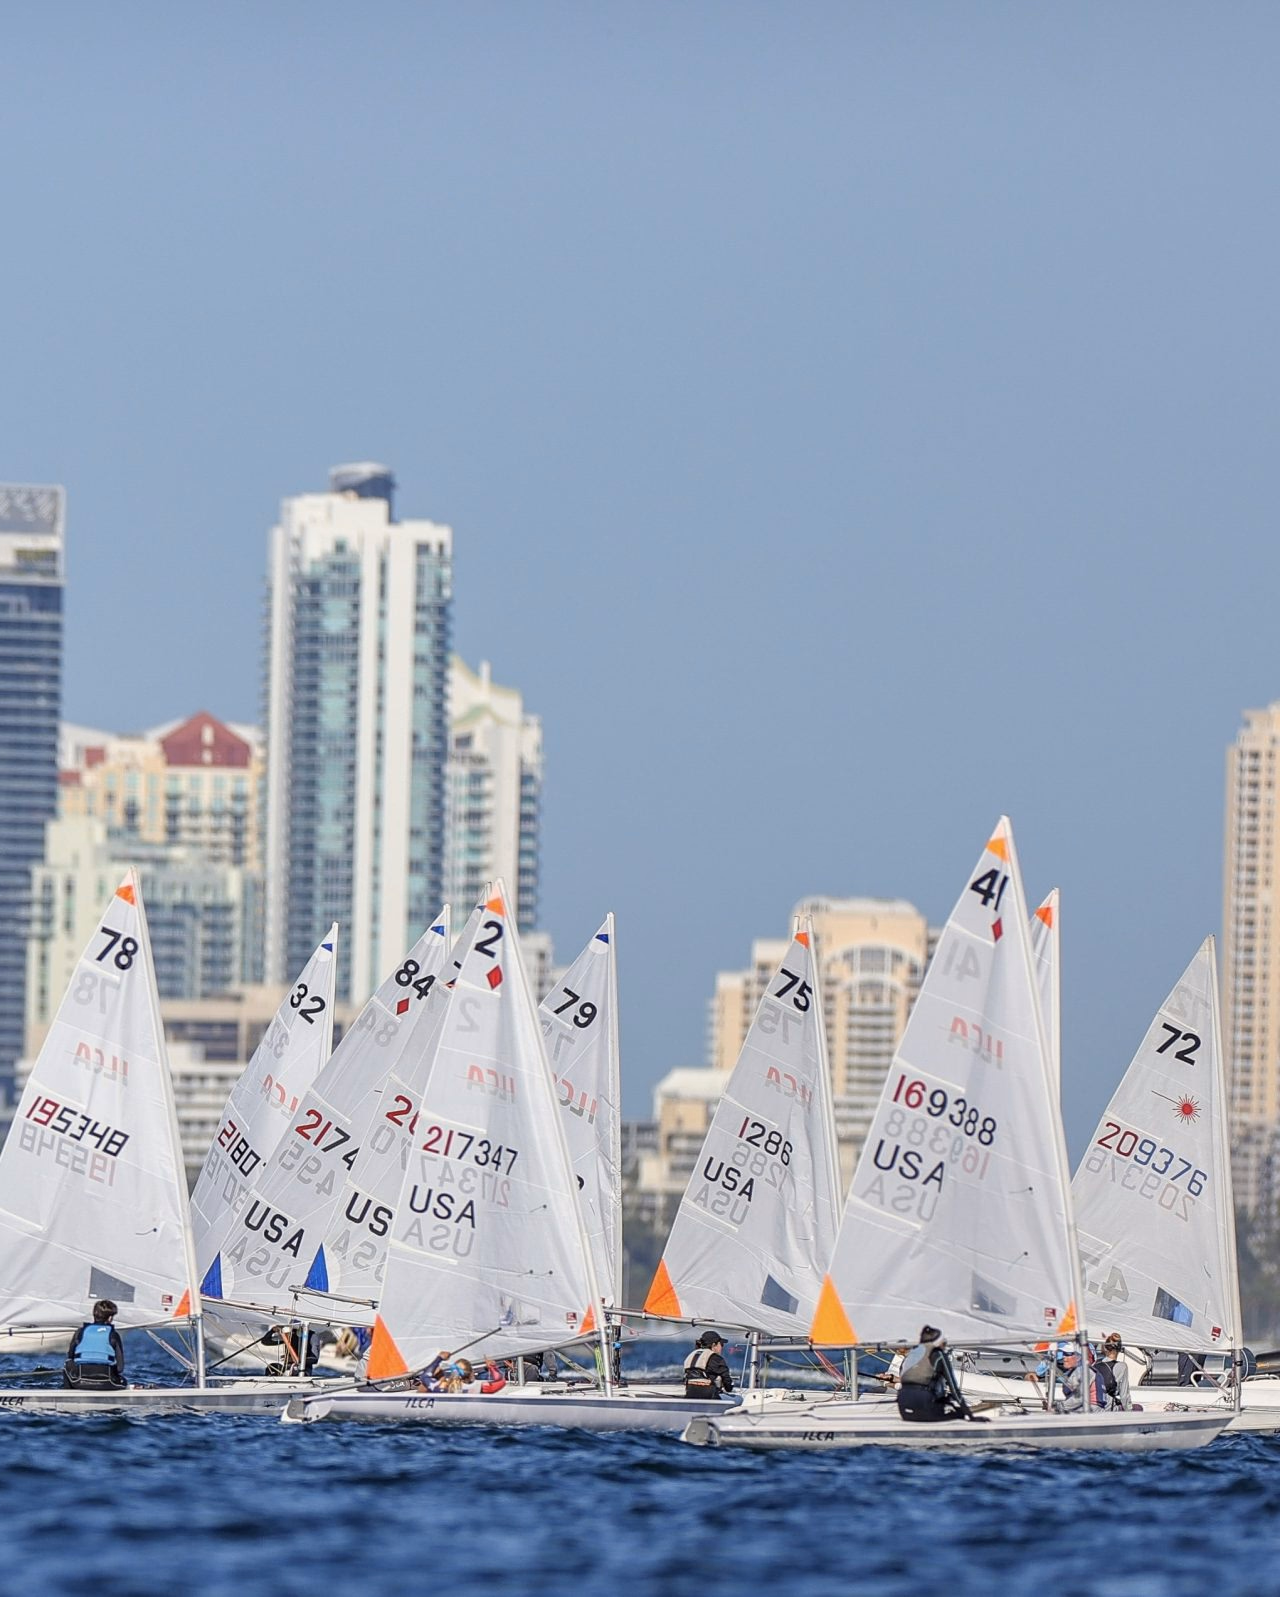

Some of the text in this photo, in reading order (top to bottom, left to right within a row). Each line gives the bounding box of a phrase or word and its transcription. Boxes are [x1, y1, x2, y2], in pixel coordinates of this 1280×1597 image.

[970, 867, 1009, 912] 41
[95, 926, 139, 971] 78
[474, 920, 503, 959] 2
[395, 959, 436, 1000] 84
[774, 968, 813, 1012] 75
[290, 983, 326, 1024] 32
[553, 987, 597, 1028] 79
[1156, 1022, 1201, 1066] 72
[26, 1096, 130, 1157] 195348
[893, 1074, 997, 1146] 169388
[217, 1120, 266, 1177] 2180
[422, 1126, 519, 1176] 217347
[738, 1116, 793, 1166] 1286
[1097, 1122, 1208, 1196] 209376
[703, 1156, 755, 1202] USA
[873, 1139, 945, 1193] USA
[245, 1200, 304, 1258] USA
[409, 1185, 476, 1229] USA
[405, 1398, 435, 1408] ILCA
[802, 1431, 835, 1442] ILCA
